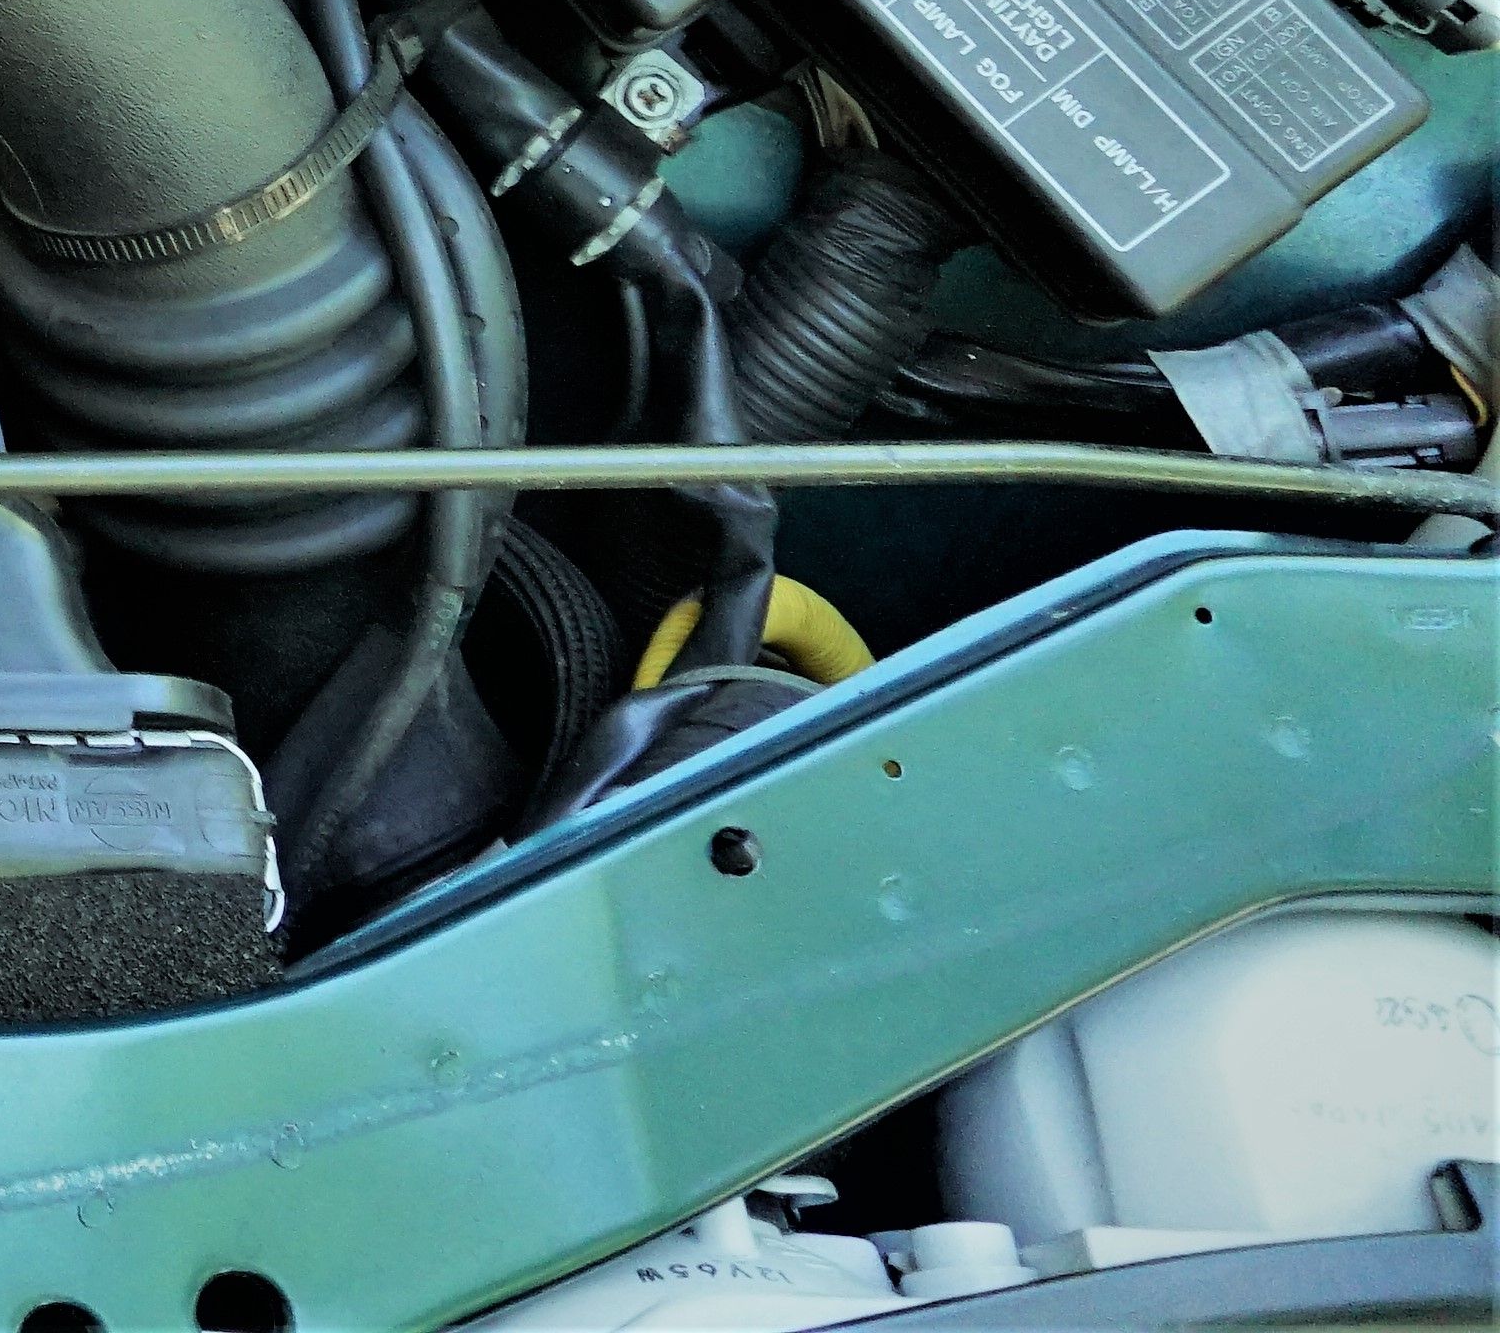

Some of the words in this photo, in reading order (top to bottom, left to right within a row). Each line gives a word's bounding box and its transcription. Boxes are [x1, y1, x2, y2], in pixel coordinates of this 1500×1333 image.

[972, 55, 1025, 104] FOG
[1049, 86, 1096, 129] DIM
[1092, 129, 1179, 212] H/LAMP
